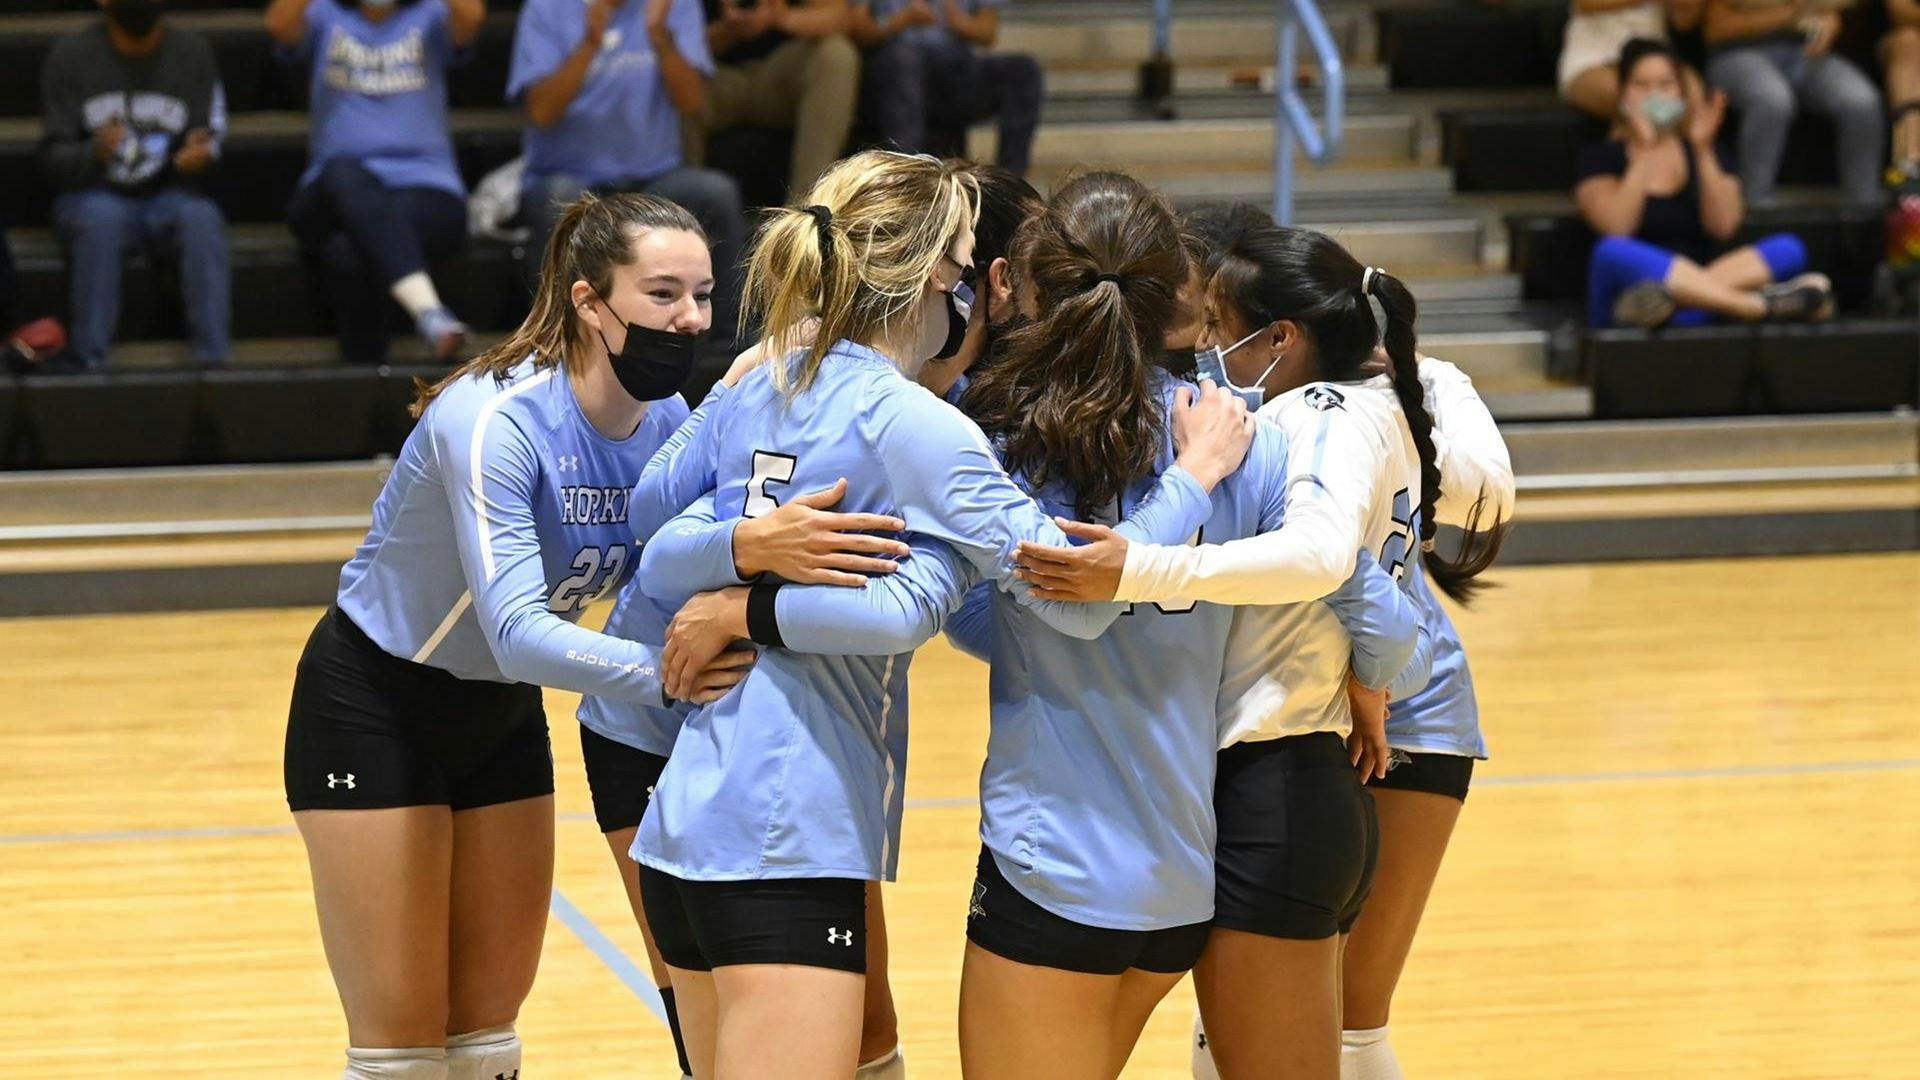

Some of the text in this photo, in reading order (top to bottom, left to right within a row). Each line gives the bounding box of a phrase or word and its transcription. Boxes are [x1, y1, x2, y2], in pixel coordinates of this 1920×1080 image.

[560, 484, 635, 525] HOPKI
[547, 543, 627, 613] 23
[565, 648, 609, 667] BLUE
